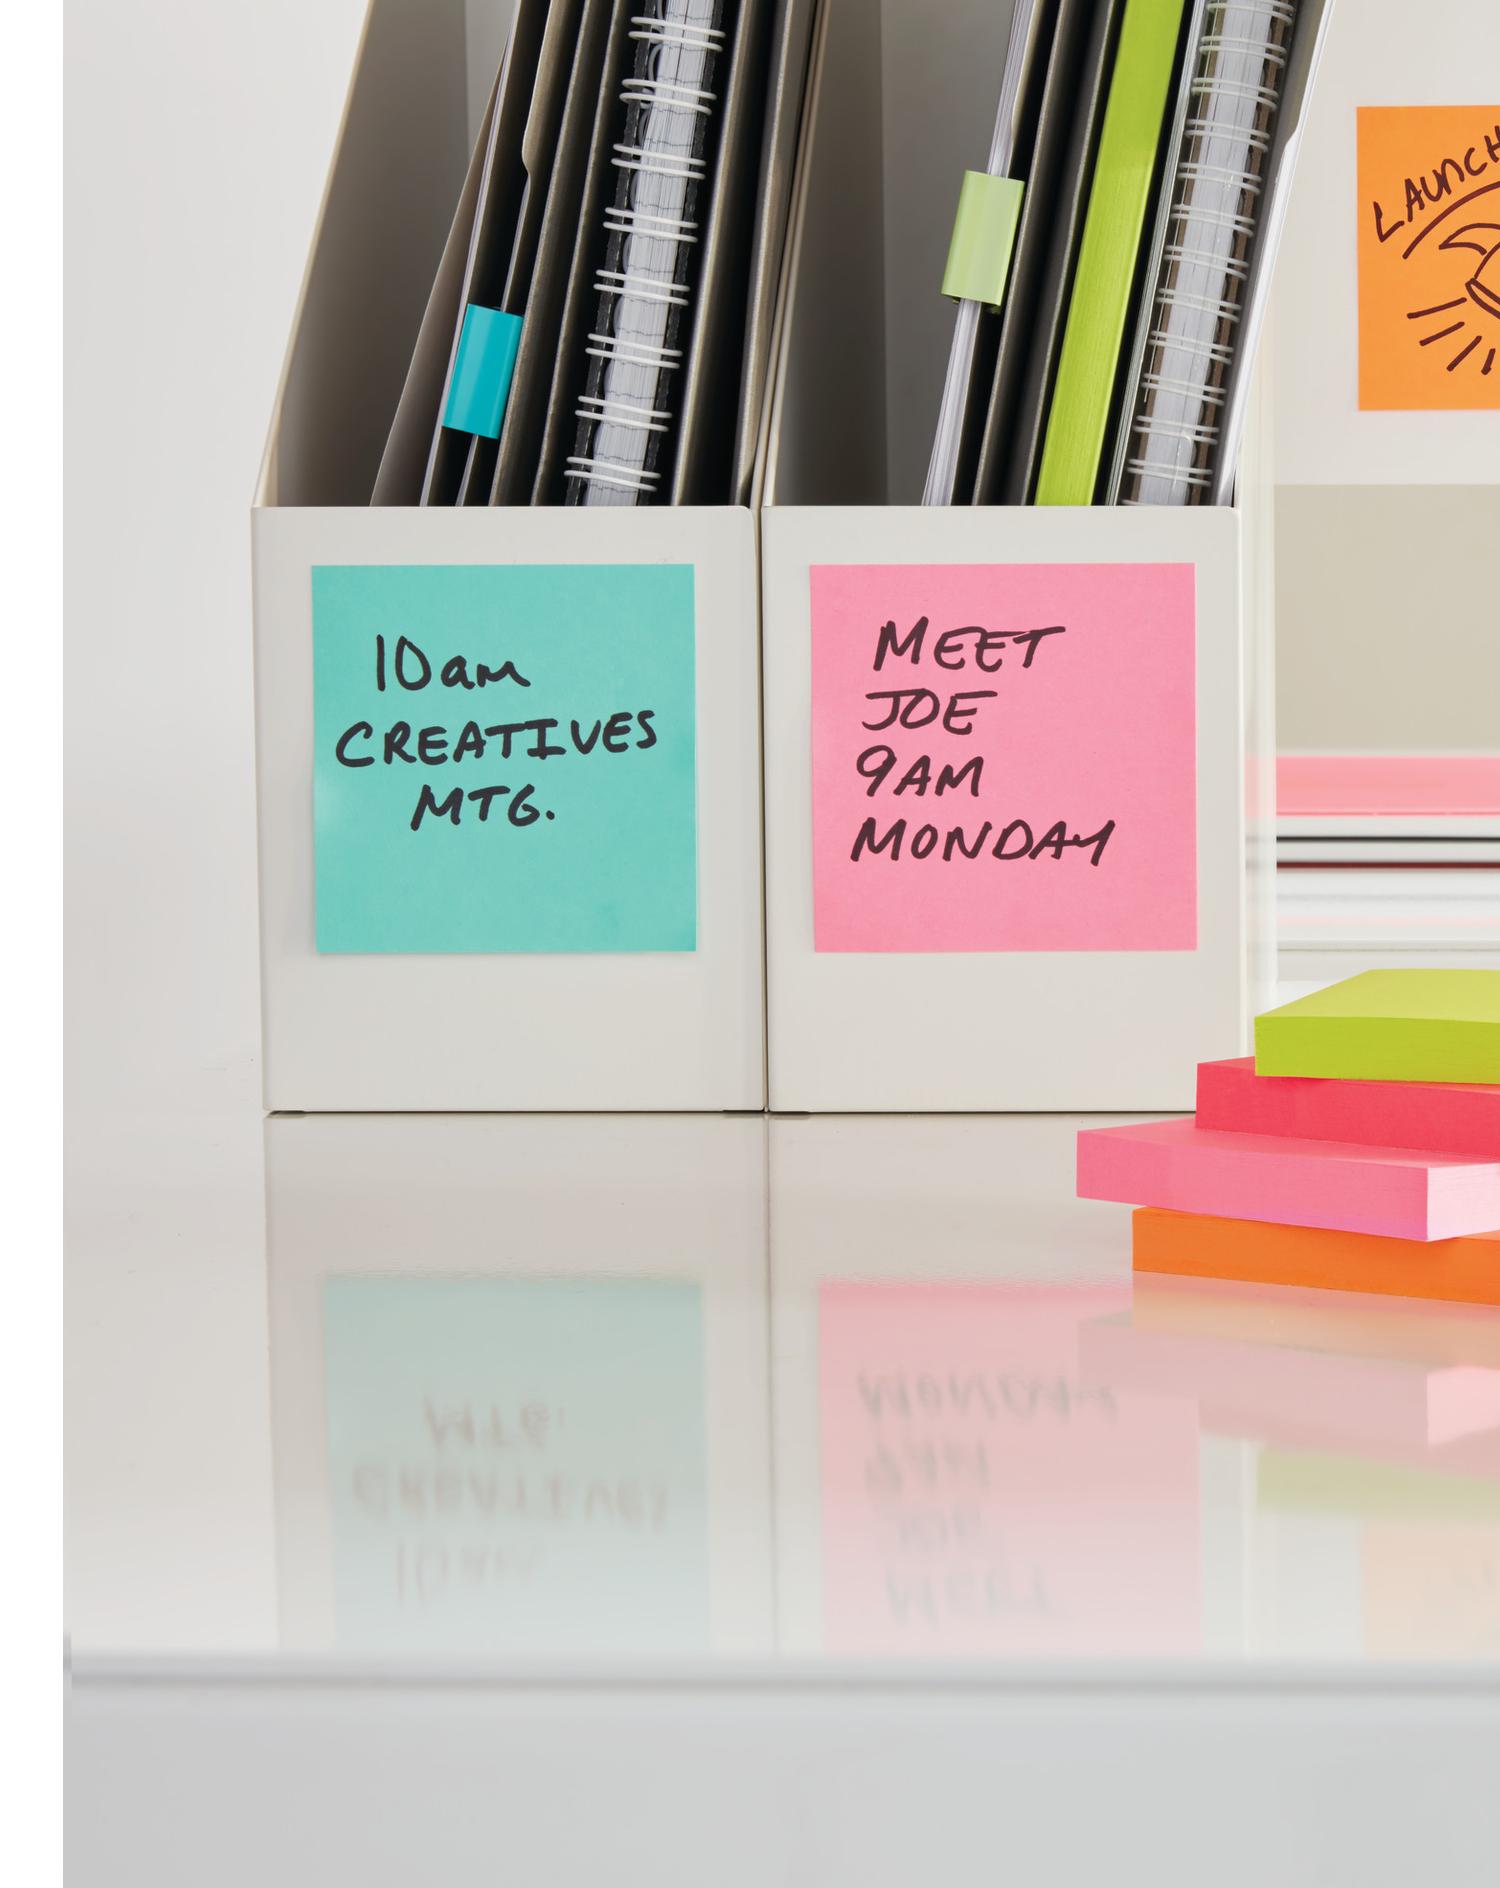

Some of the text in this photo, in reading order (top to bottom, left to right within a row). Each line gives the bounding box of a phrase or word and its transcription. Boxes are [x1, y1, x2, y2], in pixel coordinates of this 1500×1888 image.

[376, 633, 532, 692] 10am
[872, 615, 1066, 673] MEET
[335, 709, 657, 768] CREATIVES
[861, 687, 998, 736] JOE
[856, 744, 984, 798] 9AM
[410, 783, 556, 832] MTG.
[850, 816, 1116, 867] MONDAY
